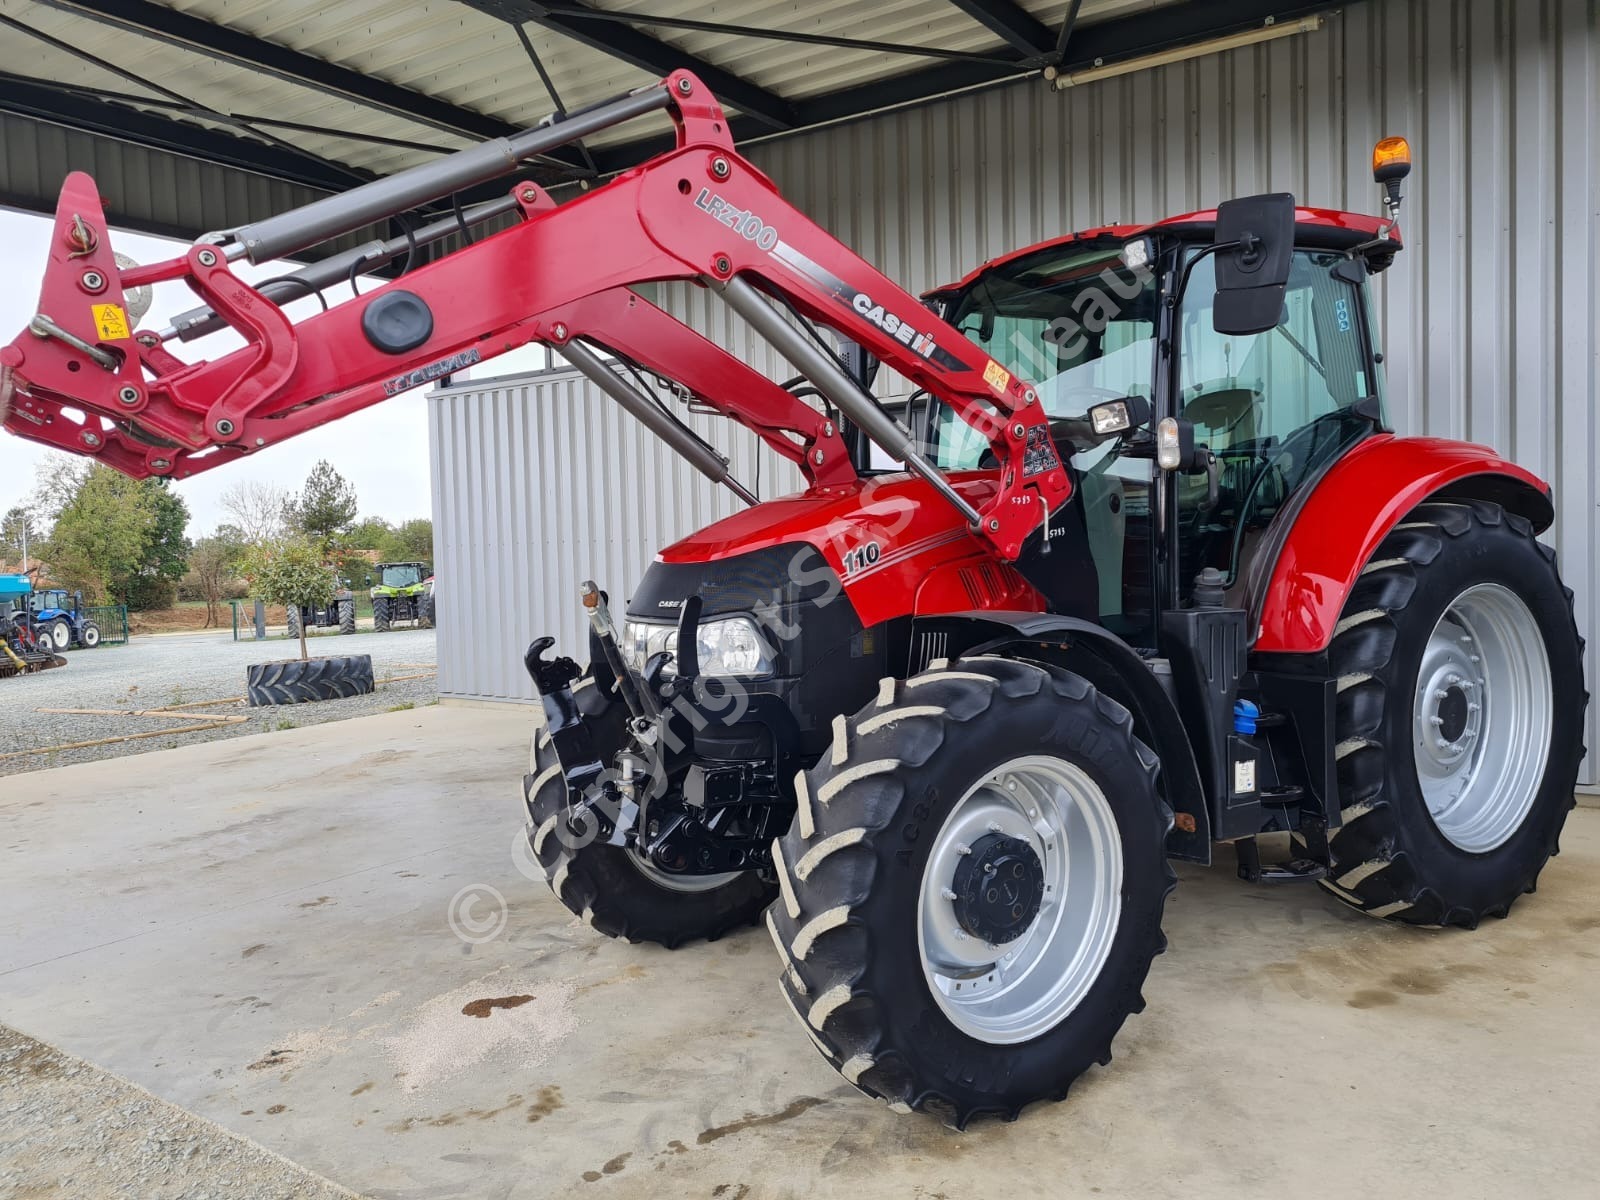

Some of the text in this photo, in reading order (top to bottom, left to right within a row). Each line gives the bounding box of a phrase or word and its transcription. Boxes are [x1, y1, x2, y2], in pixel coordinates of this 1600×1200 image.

[694, 187, 778, 251] LRZ100
[852, 293, 916, 345] CASE
[842, 541, 880, 578] 110
[658, 600, 681, 608] CASE
